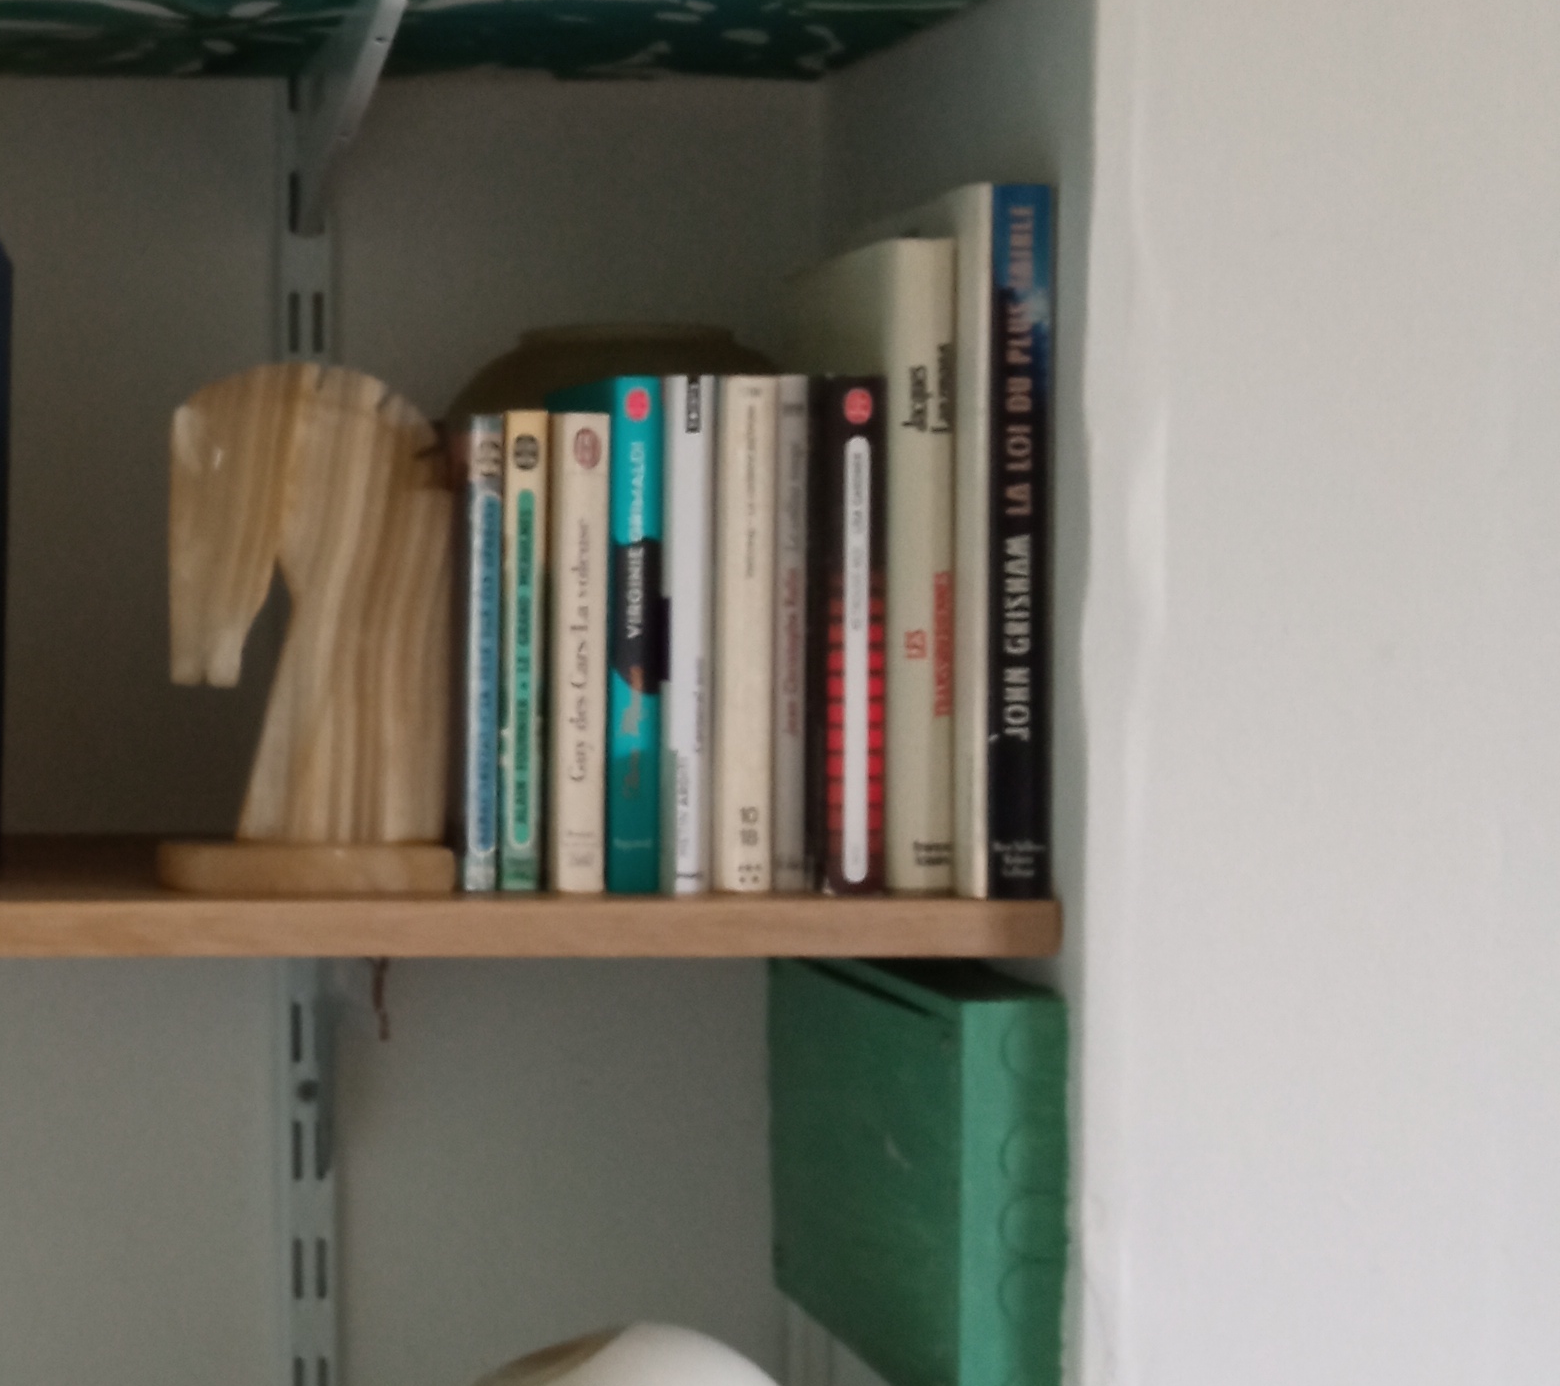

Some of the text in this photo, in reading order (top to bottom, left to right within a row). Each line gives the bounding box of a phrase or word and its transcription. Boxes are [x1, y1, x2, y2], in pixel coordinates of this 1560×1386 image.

[1001, 302, 1030, 365] PLUS
[899, 364, 932, 433] Jacques
[1001, 376, 1029, 413] DU
[1001, 424, 1029, 472] LOI
[1000, 483, 1028, 517] LA
[624, 440, 643, 639] VIRGINIE GRIMALDI
[566, 518, 592, 782] Guy des Cars La voleuse
[998, 533, 1028, 741] JOHN GRISHAM
